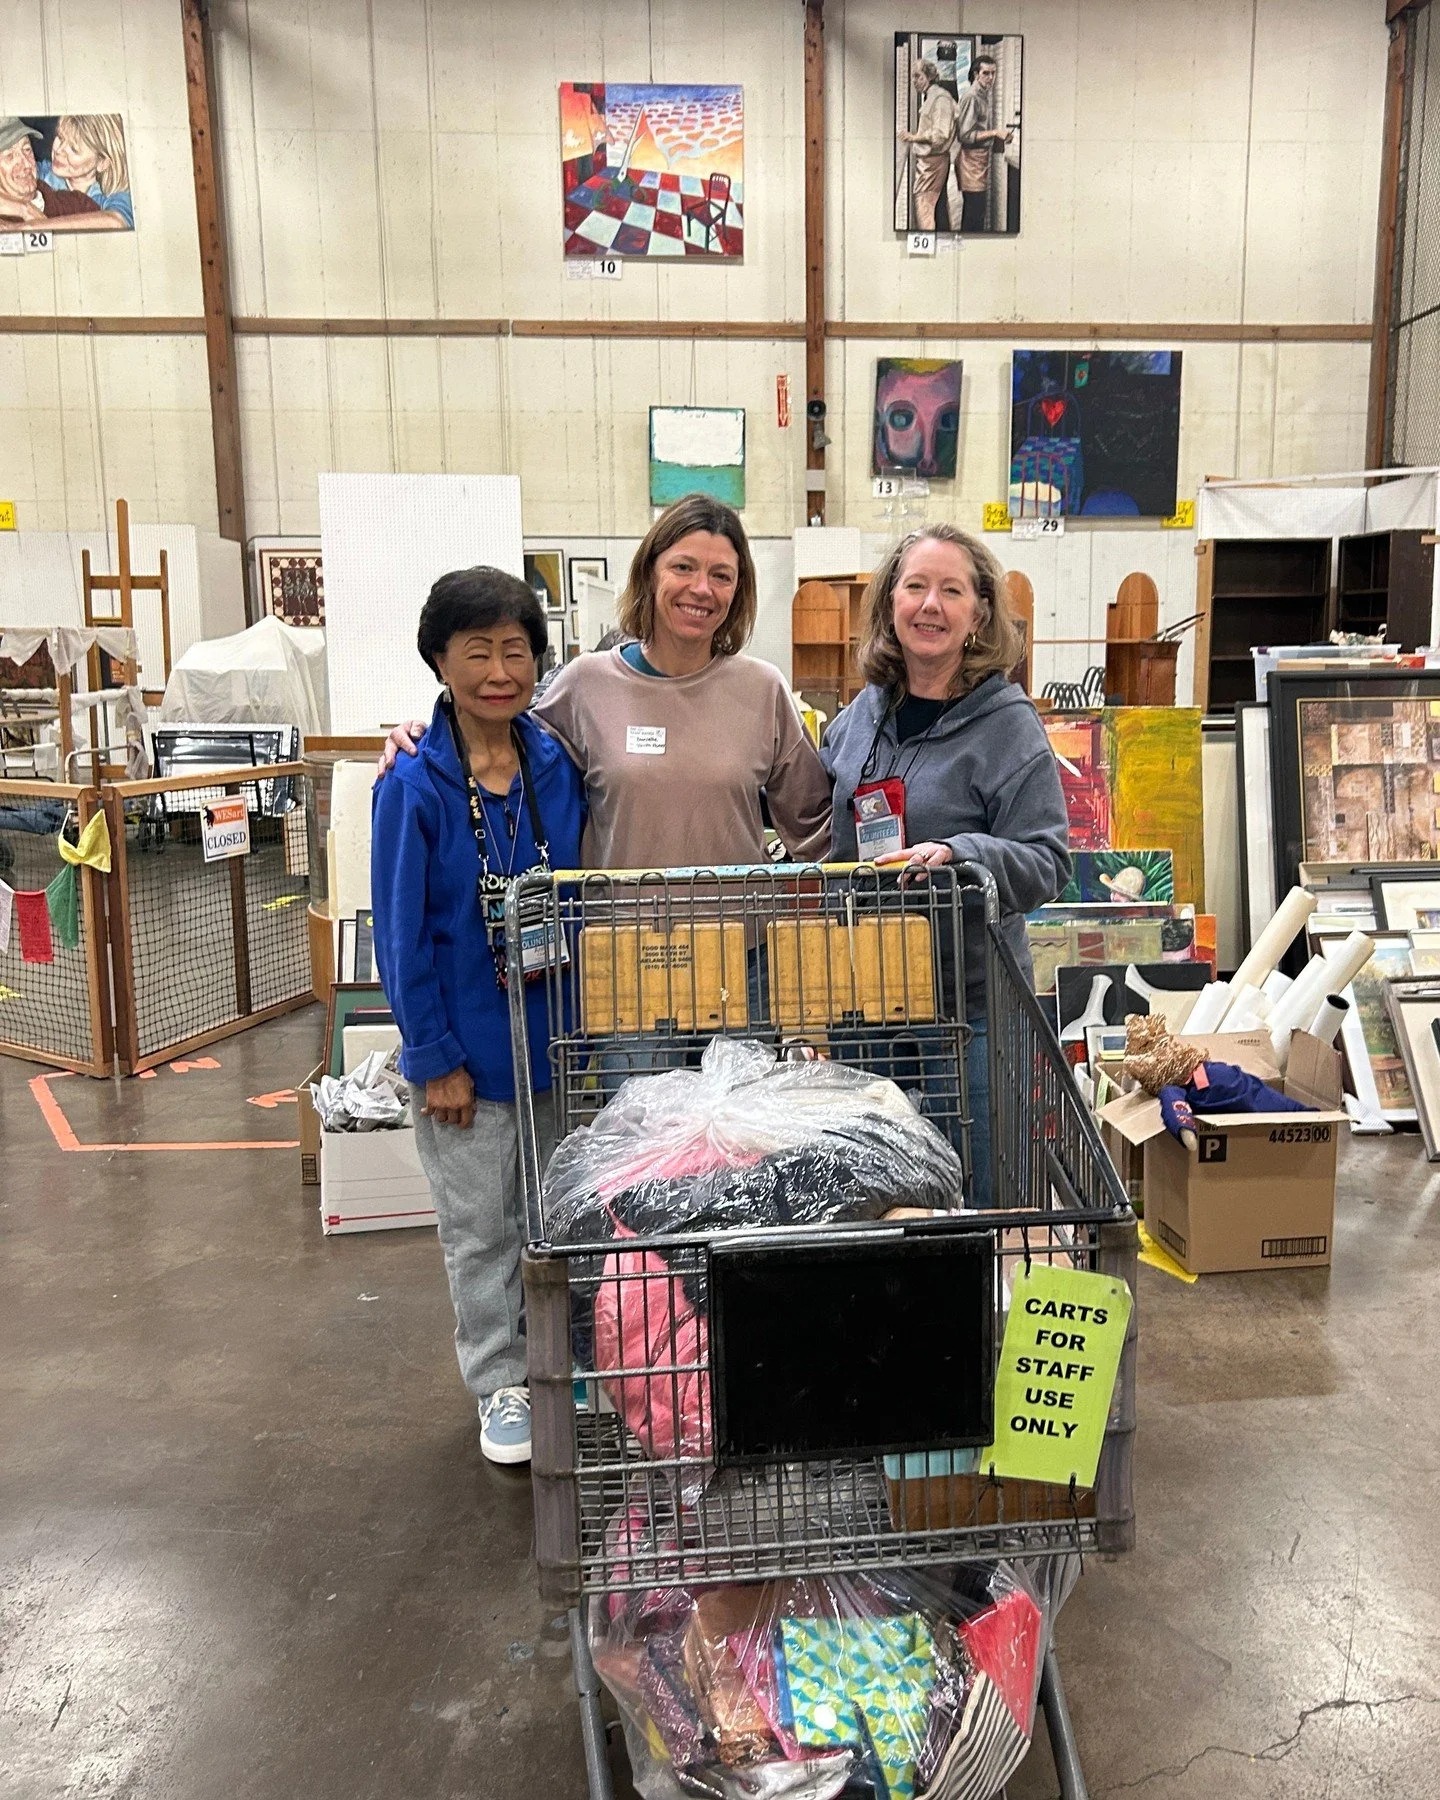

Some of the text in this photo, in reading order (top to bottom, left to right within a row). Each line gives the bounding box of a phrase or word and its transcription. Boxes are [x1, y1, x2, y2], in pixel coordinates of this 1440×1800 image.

[30, 233, 48, 247] 20
[913, 236, 929, 249] 50
[600, 260, 616, 274] 10
[879, 481, 893, 494] 13
[1042, 519, 1058, 532] 29
[208, 832, 246, 850] CLOSED
[1205, 1138, 1221, 1159] P
[1025, 1298, 1108, 1325] CARTS
[1036, 1329, 1086, 1352] FOR
[1016, 1357, 1095, 1381] STAFF
[1025, 1387, 1075, 1409] USE
[1010, 1415, 1079, 1439] ONLY
